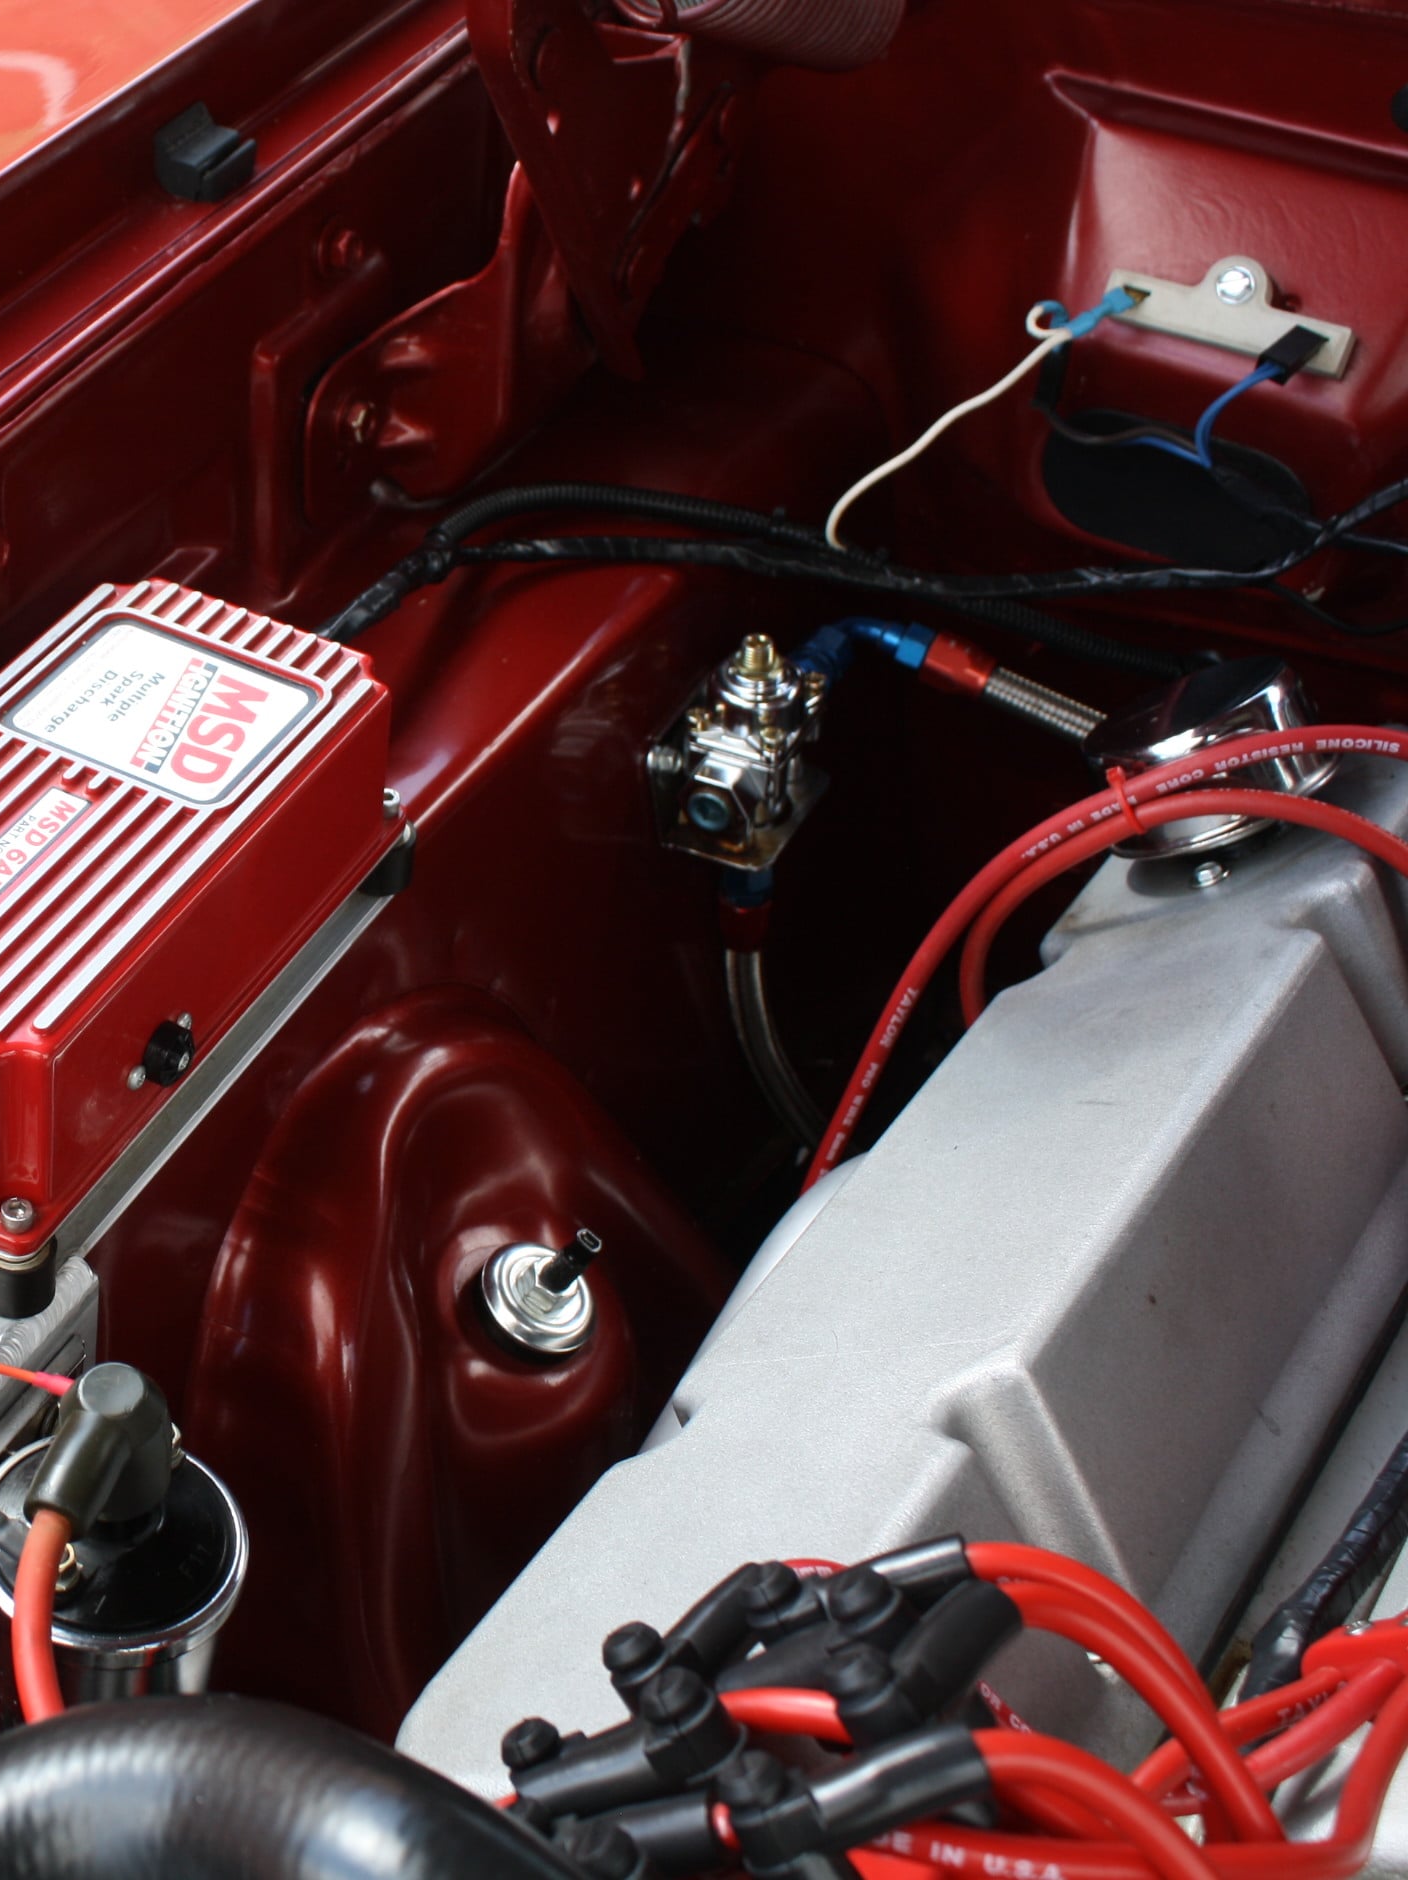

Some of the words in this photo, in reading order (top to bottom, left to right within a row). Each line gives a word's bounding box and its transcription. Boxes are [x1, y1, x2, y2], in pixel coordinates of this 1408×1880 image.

[45, 669, 119, 734] Discharge
[99, 671, 144, 707] Spark
[107, 672, 166, 723] Multiple
[133, 661, 215, 768] IGNITION
[171, 675, 269, 784] MSD
[1214, 741, 1304, 772] RESISTOR
[1316, 737, 1400, 753] SILICONE
[1155, 768, 1204, 794] CORE
[11, 814, 37, 840] PART
[24, 800, 78, 847] MSD
[1066, 819, 1085, 833] IN
[1020, 832, 1062, 859] U.S.A.
[879, 986, 920, 1048] TAYLOR
[861, 1062, 879, 1089] PRO
[843, 1095, 864, 1127] WIRE
[929, 1840, 966, 1868] IN
